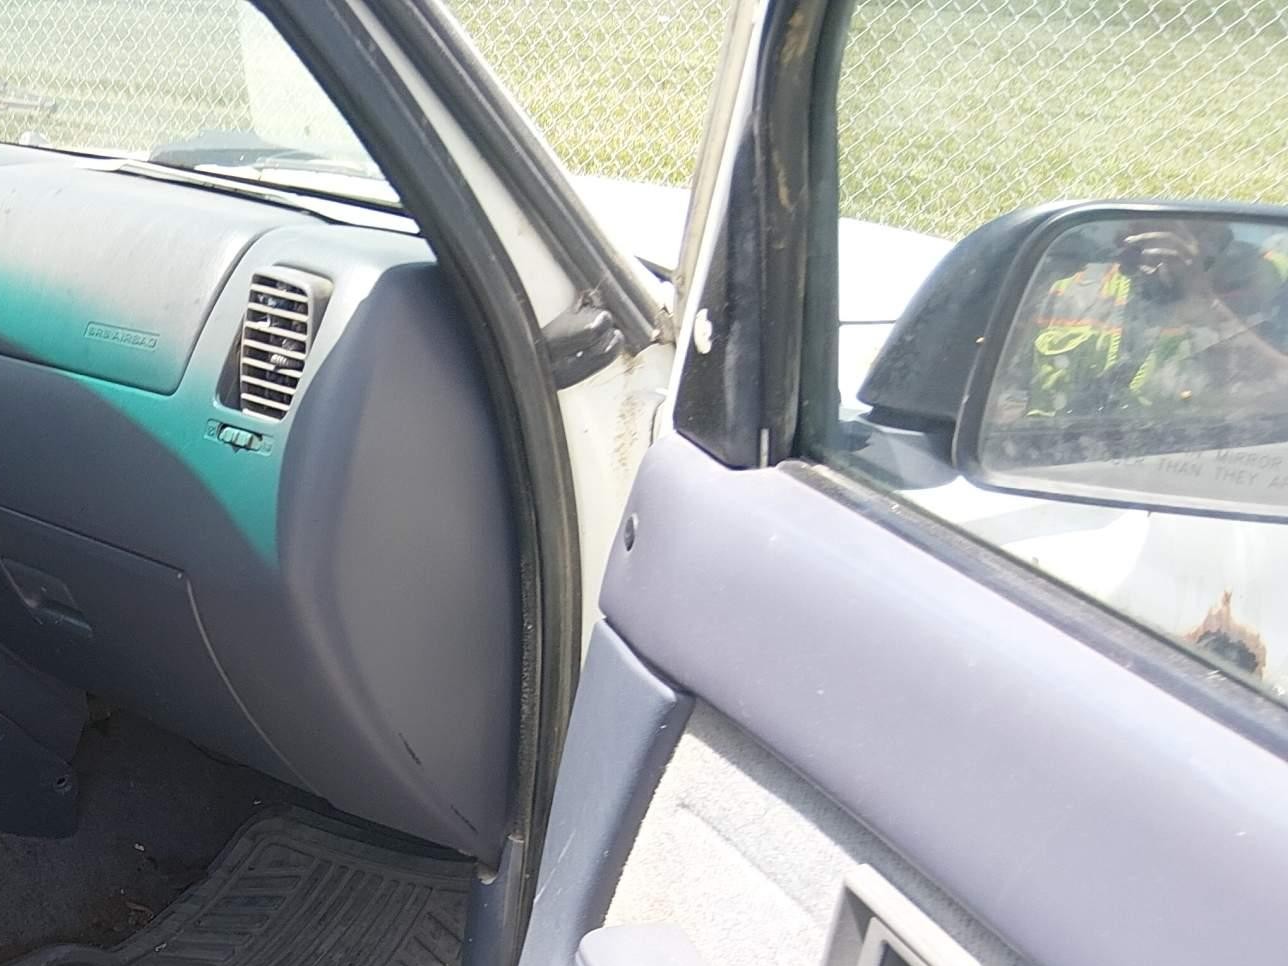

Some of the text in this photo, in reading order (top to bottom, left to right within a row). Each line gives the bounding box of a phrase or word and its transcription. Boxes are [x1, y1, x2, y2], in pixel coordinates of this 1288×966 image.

[1158, 457, 1203, 478] THAN
[1215, 465, 1259, 487] THEY
[1216, 450, 1283, 470] MIRROR
